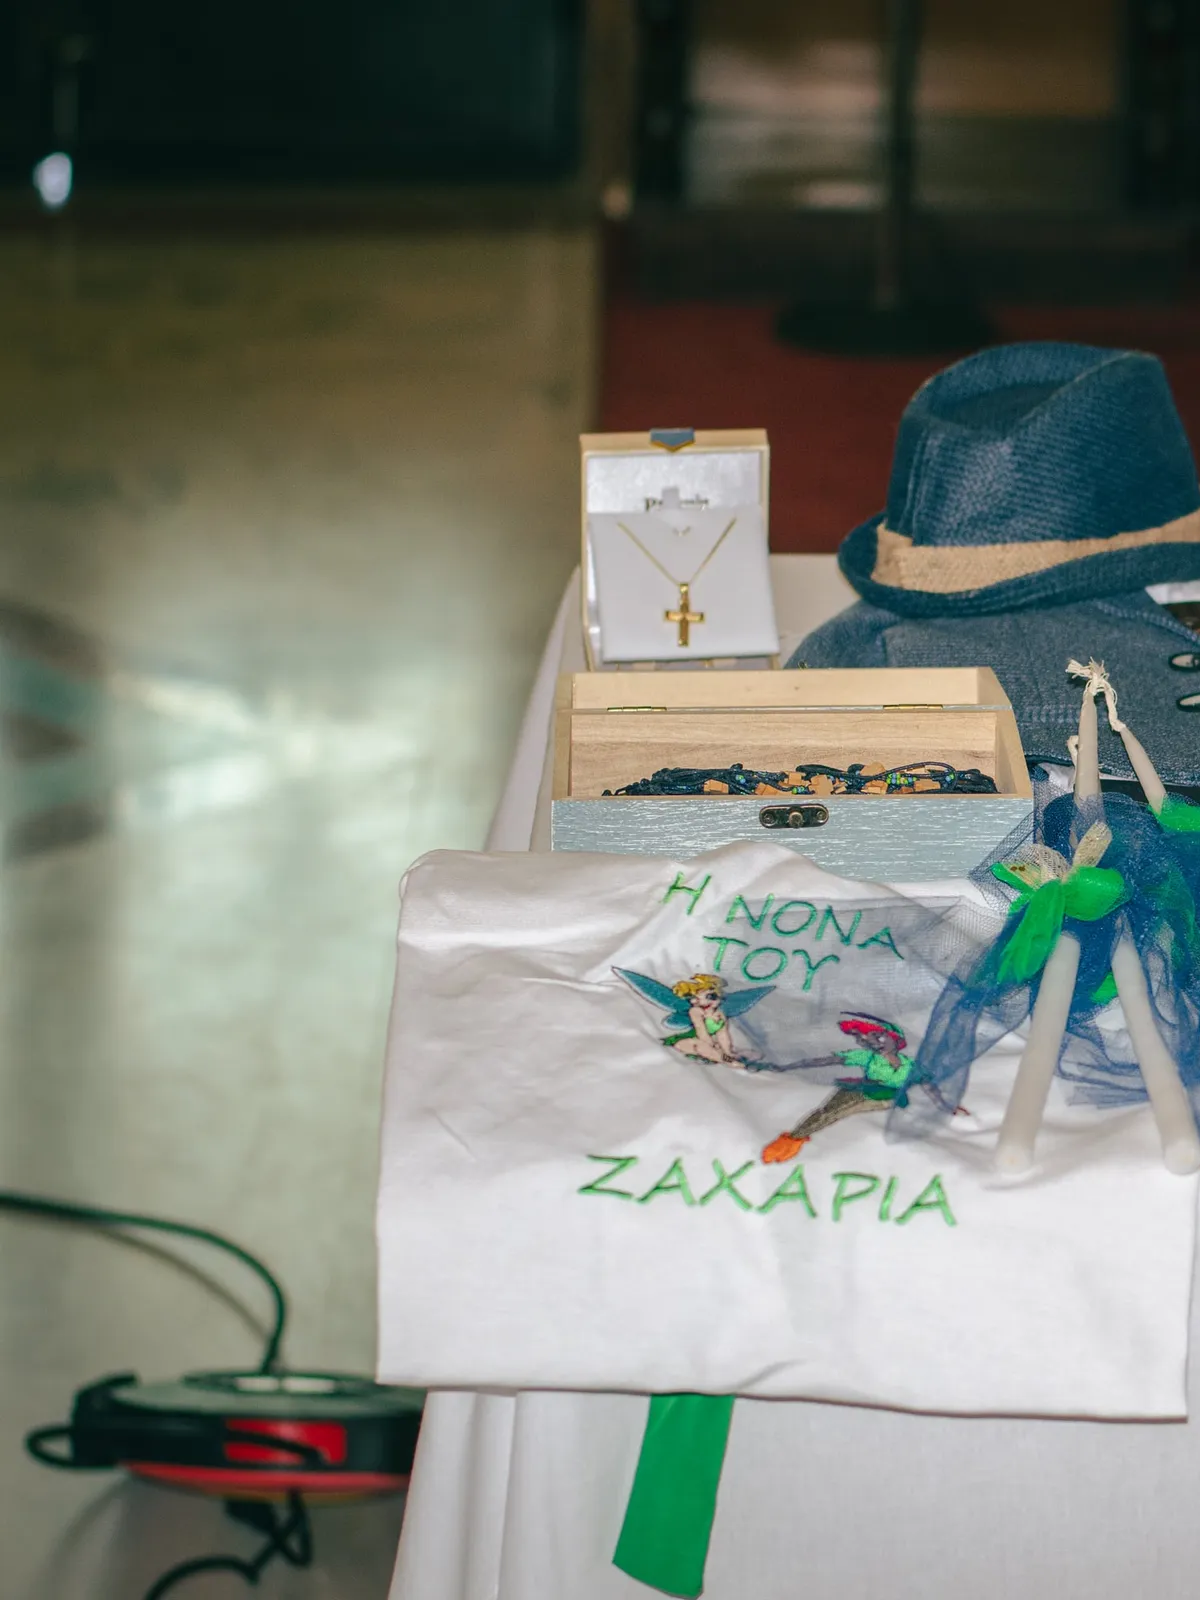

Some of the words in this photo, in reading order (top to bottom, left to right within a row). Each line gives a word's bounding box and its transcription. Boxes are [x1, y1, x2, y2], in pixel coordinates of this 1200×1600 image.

[660, 871, 711, 916] Η
[725, 893, 904, 960] ΝΟΝΑ
[703, 935, 840, 992] ΤΟΥ
[577, 1154, 957, 1226] ΖΑΧΑΡΙΑ
